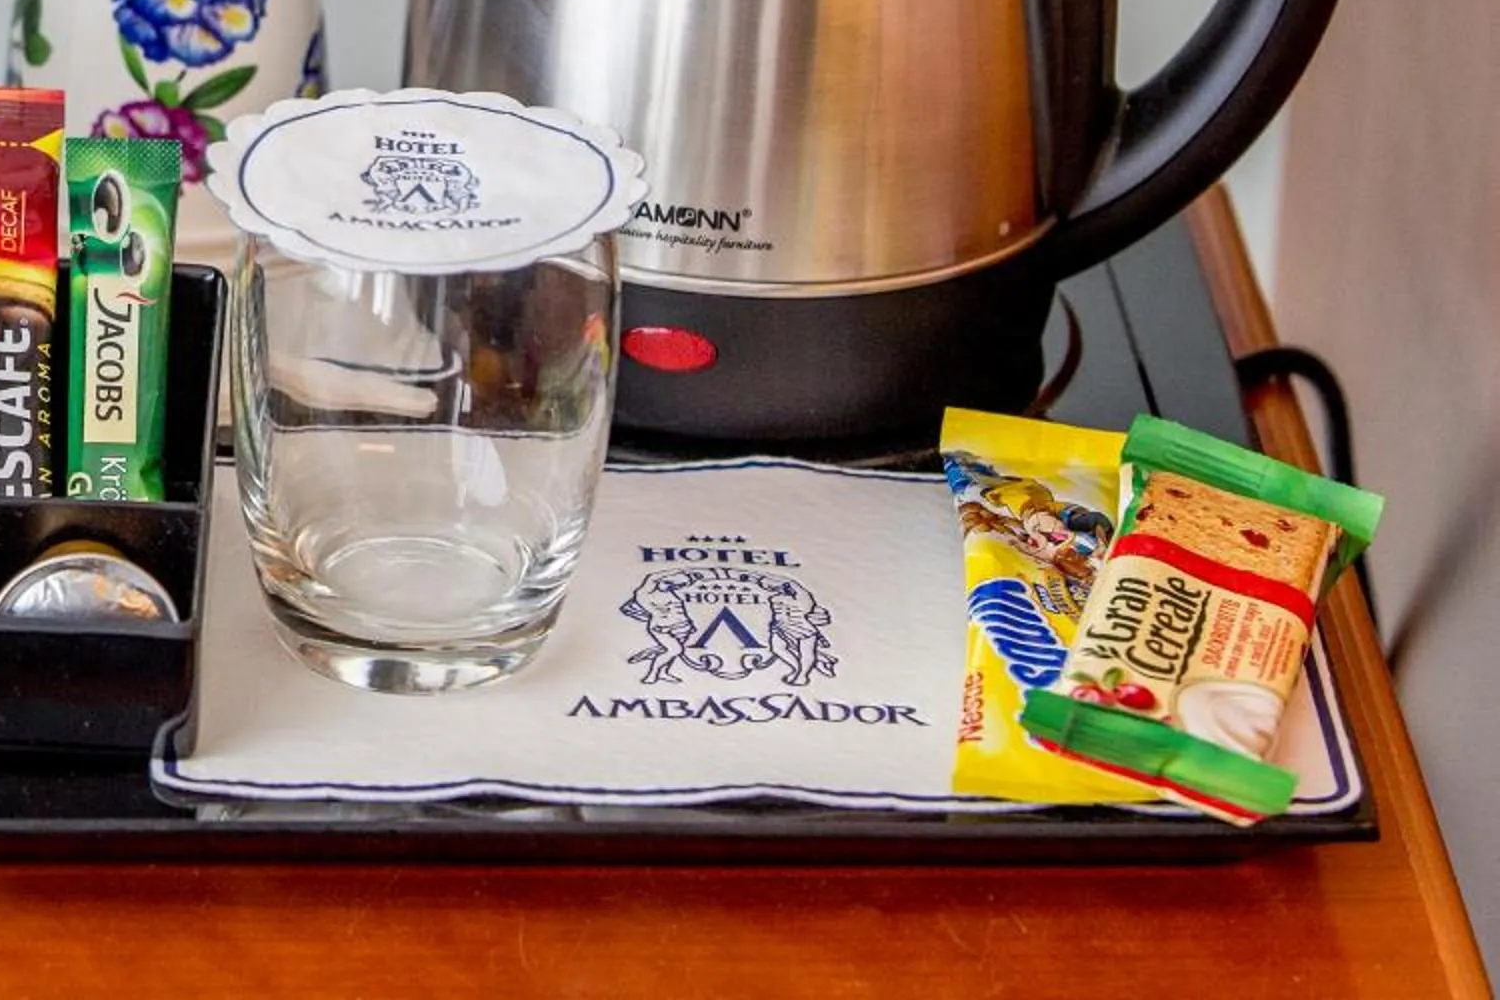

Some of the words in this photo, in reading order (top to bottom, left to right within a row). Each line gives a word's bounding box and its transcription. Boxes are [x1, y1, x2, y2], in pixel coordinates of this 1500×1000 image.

[375, 135, 465, 155] HOTEL
[1, 189, 18, 252] DECAF
[93, 287, 133, 422] JACOBS
[37, 342, 54, 447] AROMA
[639, 545, 802, 568] HOTEL
[684, 591, 769, 605] HOTEL
[1086, 577, 1153, 643] Gran
[1125, 576, 1203, 675] Cereale
[567, 693, 931, 726] AMBASSADOR
